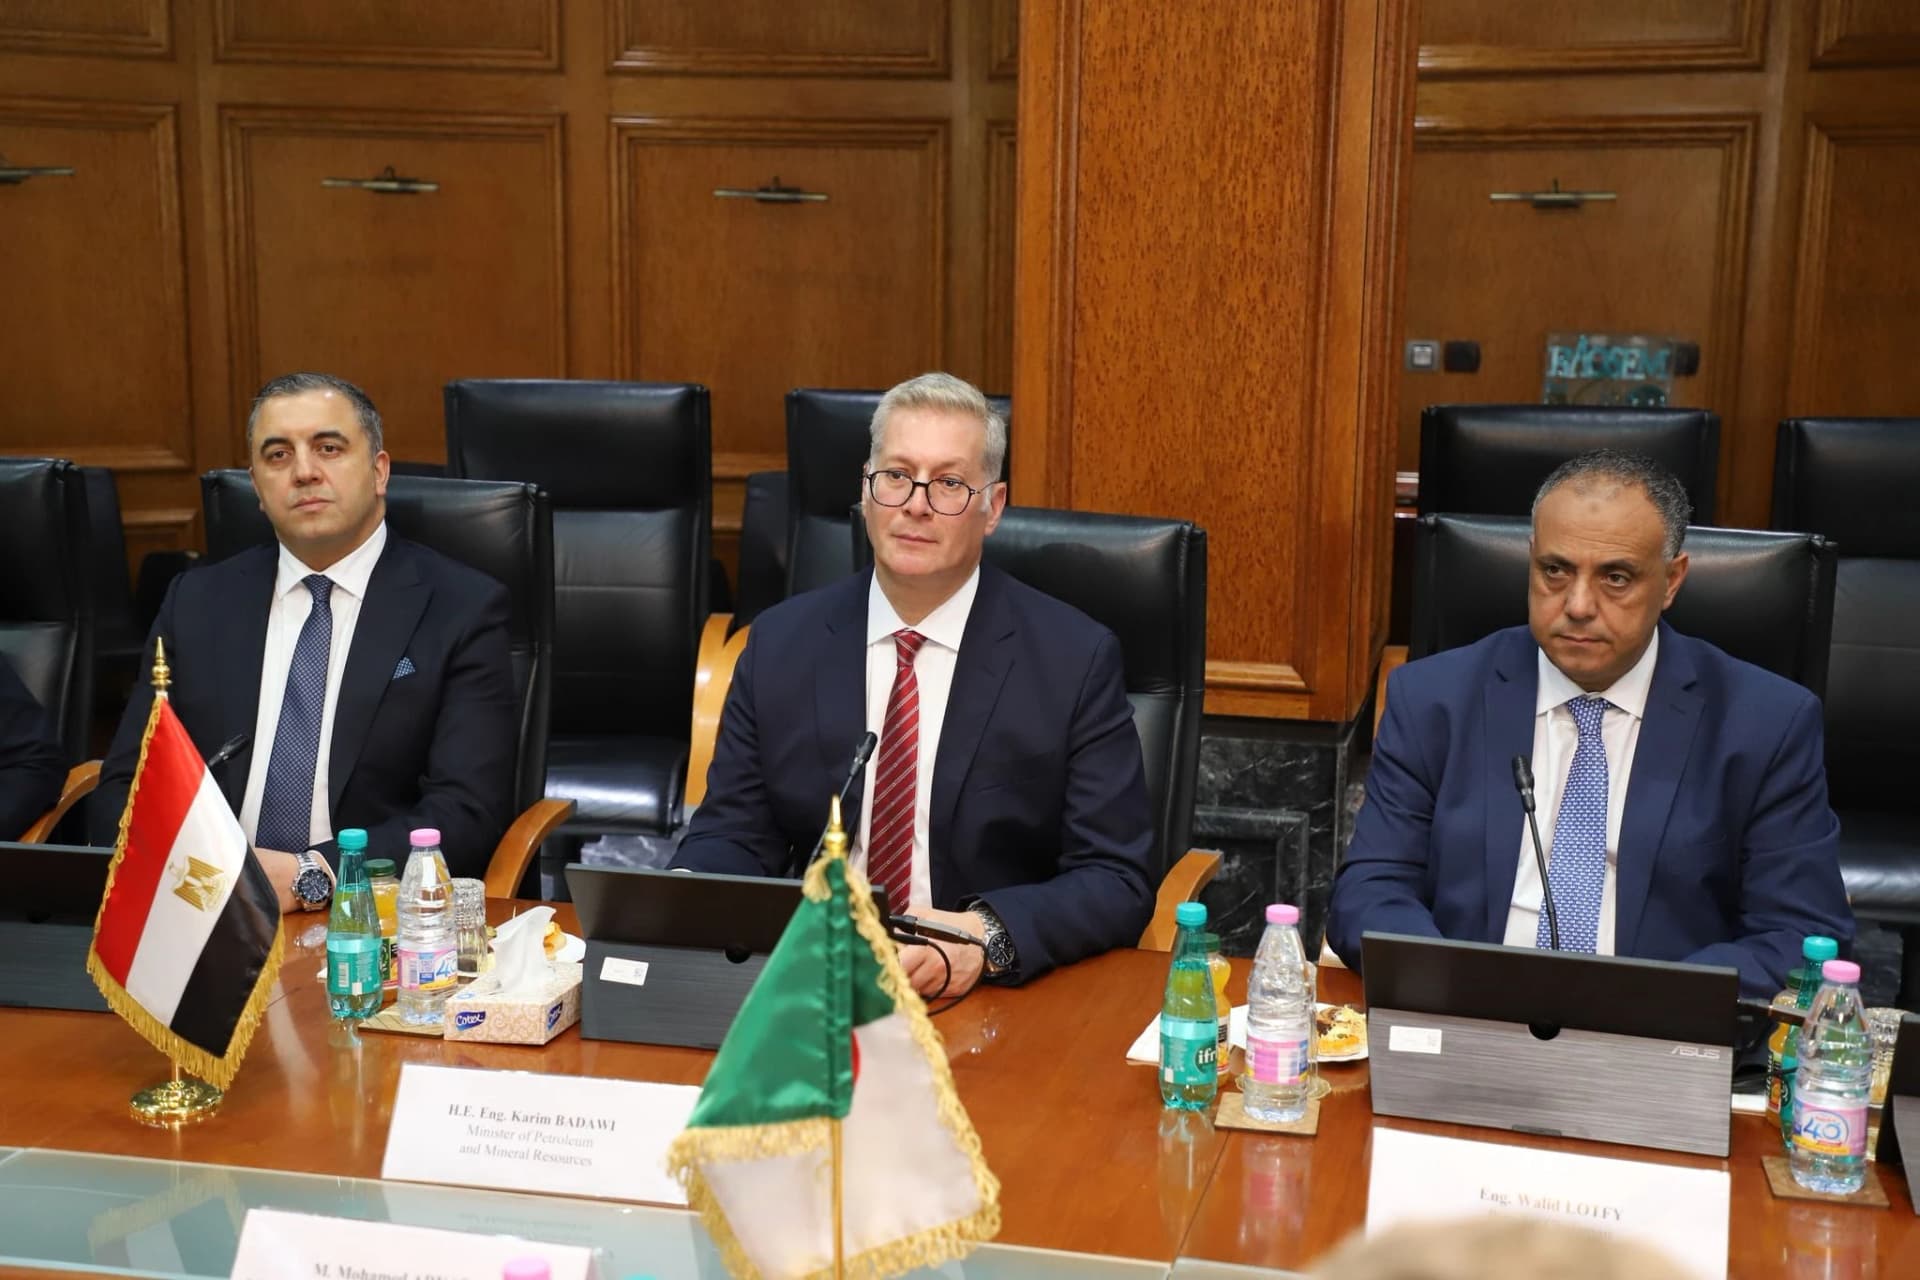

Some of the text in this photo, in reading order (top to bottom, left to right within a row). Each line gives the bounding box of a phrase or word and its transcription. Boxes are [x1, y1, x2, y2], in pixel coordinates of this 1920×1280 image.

[1671, 1045, 1720, 1059] ASUS
[448, 1103, 616, 1132] H.E. Eng. Karim BADAWI
[466, 1124, 594, 1148] Minister of Petroleum
[458, 1144, 593, 1167] and Mineral Resources
